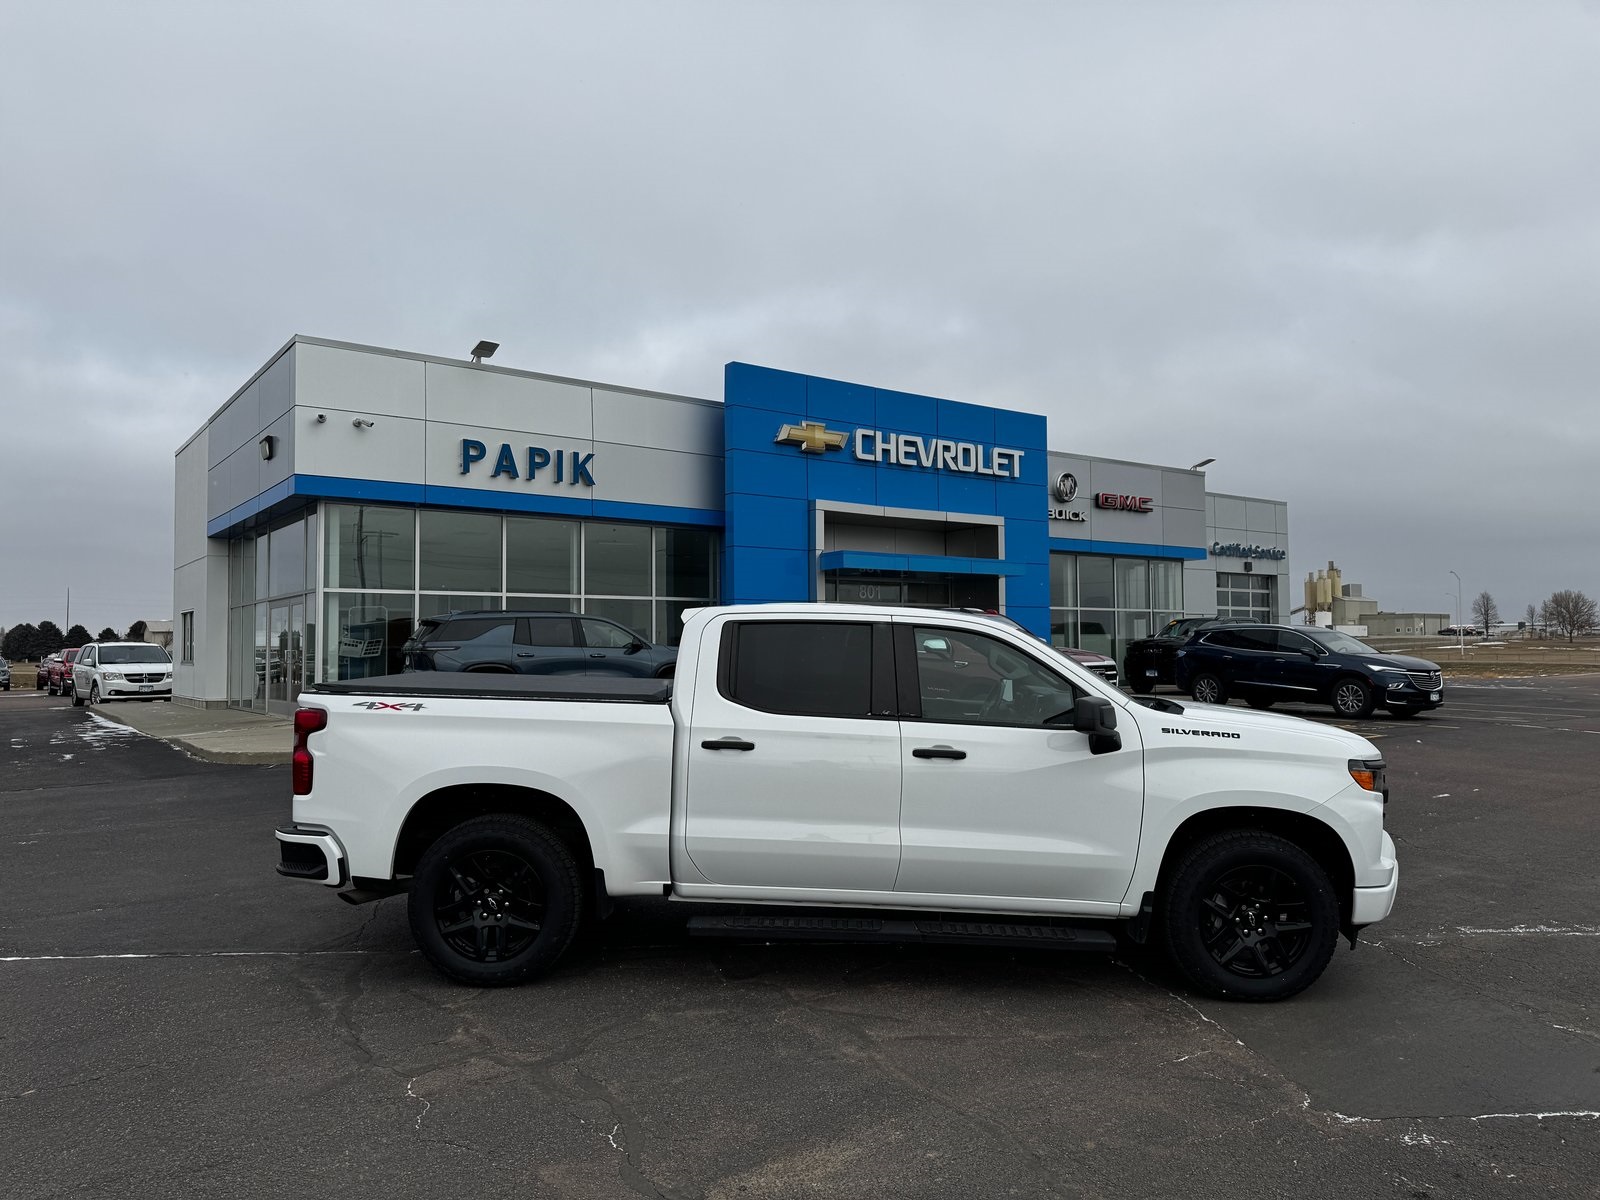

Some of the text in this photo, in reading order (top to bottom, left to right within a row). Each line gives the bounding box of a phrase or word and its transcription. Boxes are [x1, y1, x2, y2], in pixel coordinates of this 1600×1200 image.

[460, 438, 596, 486] PAPIK
[853, 428, 1025, 478] CHEVROLET
[1096, 492, 1154, 513] GMC
[859, 584, 881, 599] 801
[1161, 727, 1241, 739] SILVERADO
